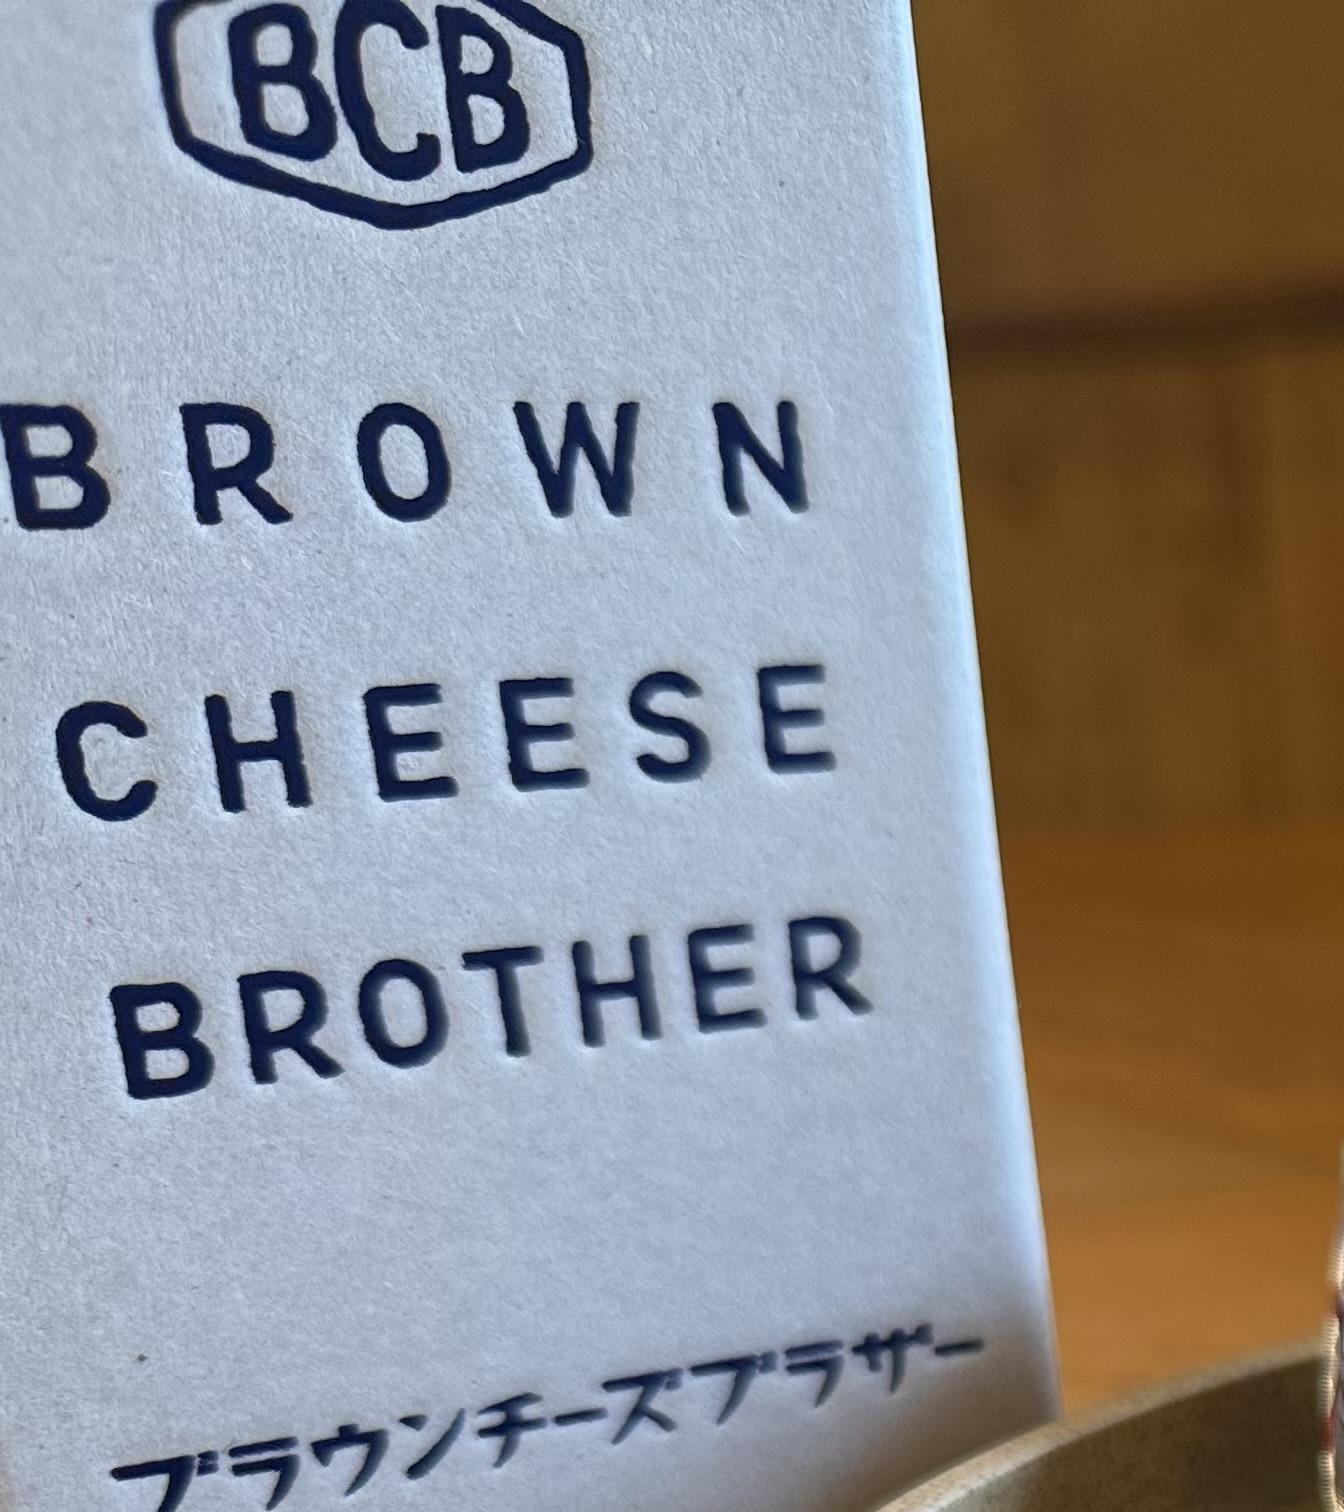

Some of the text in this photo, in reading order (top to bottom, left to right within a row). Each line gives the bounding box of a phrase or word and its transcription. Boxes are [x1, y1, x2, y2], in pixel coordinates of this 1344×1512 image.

[228, 0, 530, 181] BCB
[2, 401, 810, 530] BROWN
[55, 664, 836, 823] CHEESE
[109, 915, 874, 1100] BROTHER
